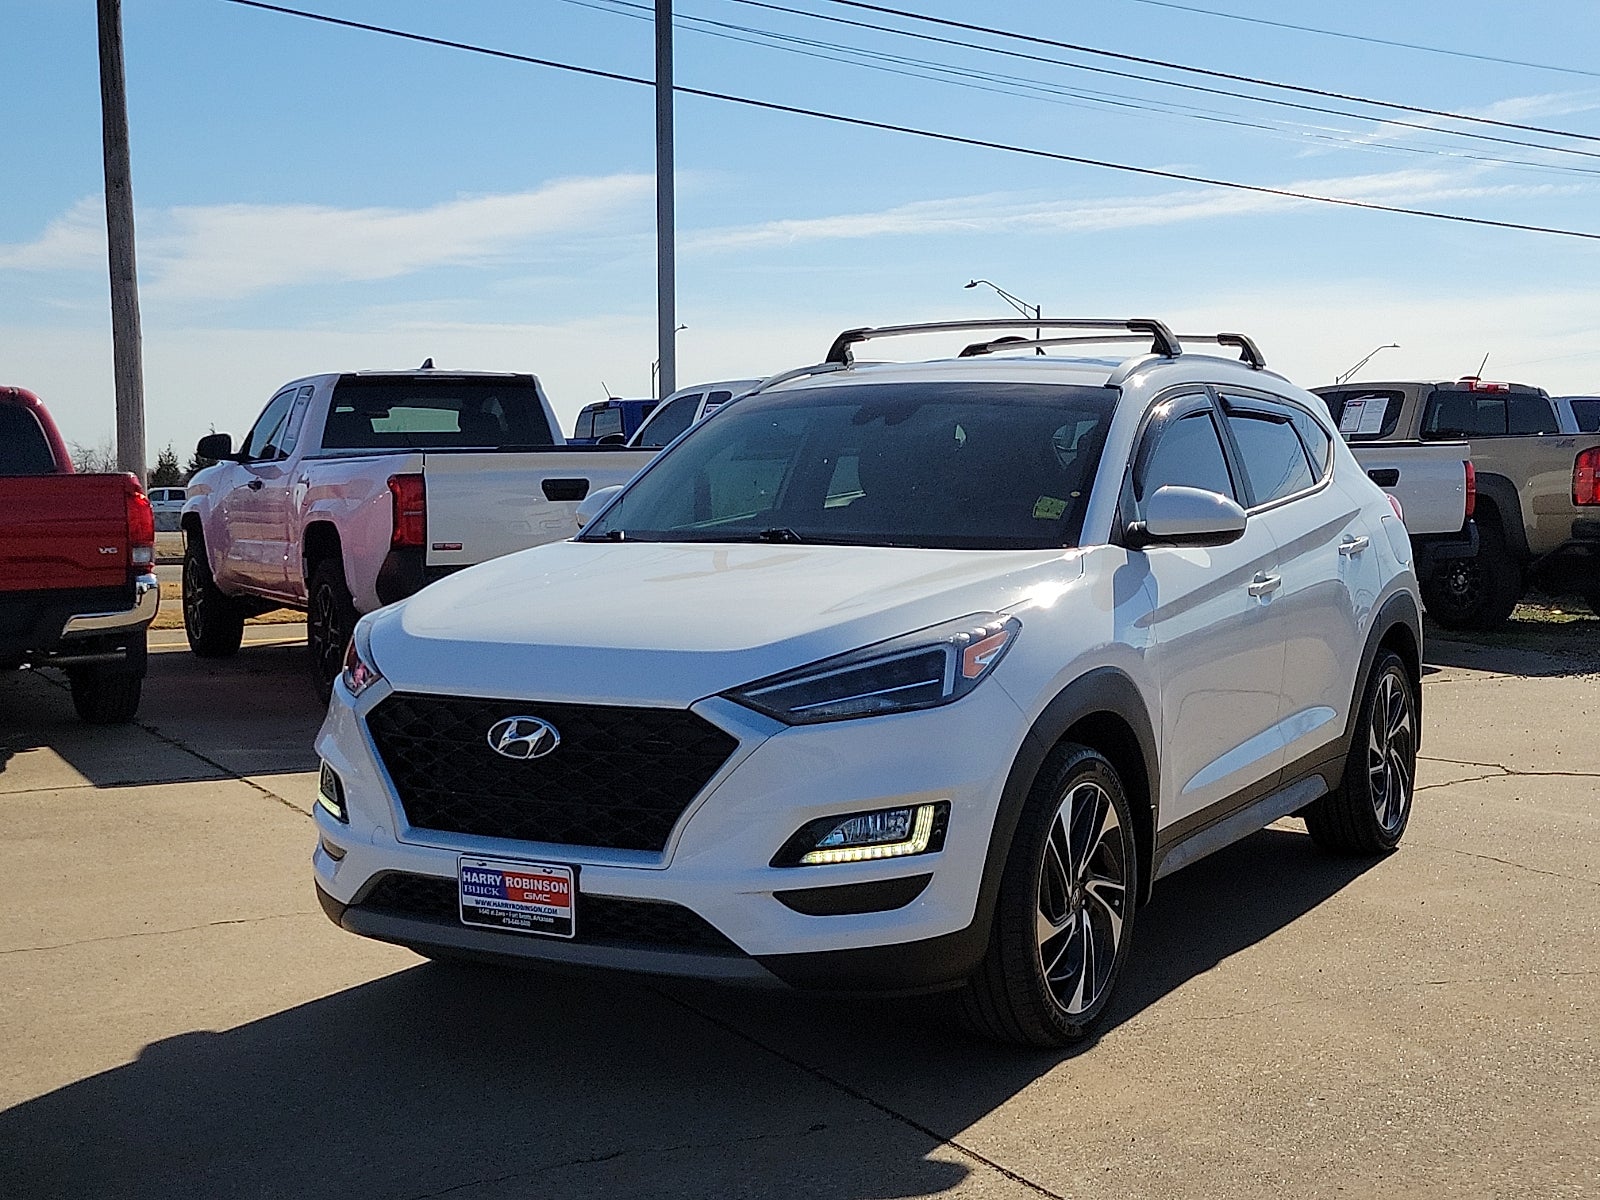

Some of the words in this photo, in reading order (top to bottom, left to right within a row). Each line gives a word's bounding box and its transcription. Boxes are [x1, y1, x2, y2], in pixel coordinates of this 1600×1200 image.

[462, 871, 502, 886] HARRY
[505, 876, 569, 894] ROBINSON
[464, 884, 500, 896] BUICK
[523, 892, 552, 902] GMC
[474, 899, 558, 915] WWW.HARRYROBINSON.COM
